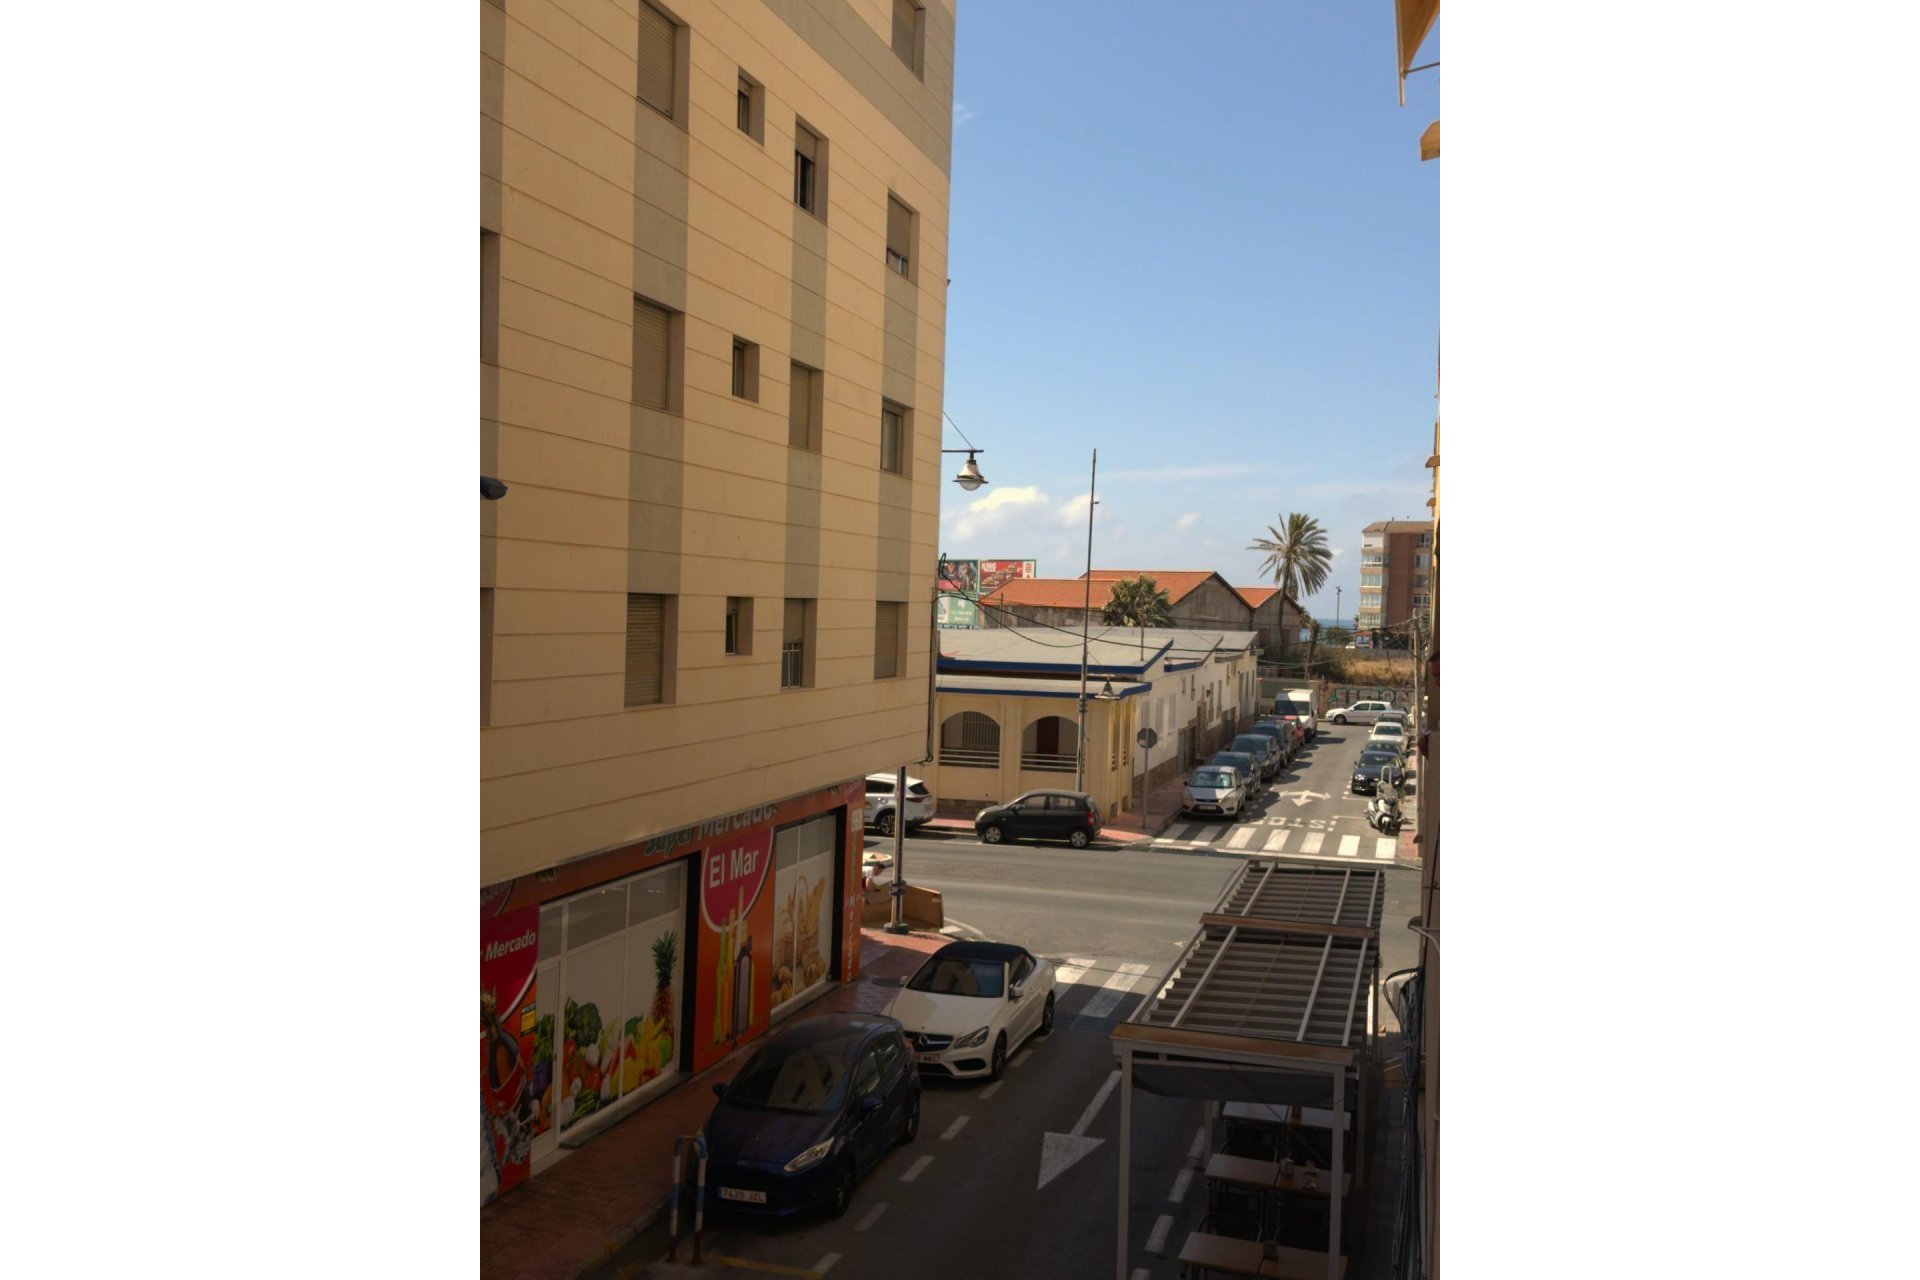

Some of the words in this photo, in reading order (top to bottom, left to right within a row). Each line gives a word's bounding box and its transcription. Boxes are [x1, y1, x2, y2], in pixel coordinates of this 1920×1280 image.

[709, 852, 725, 889] El
[730, 847, 759, 881] Mar
[485, 928, 537, 962] Mercado
